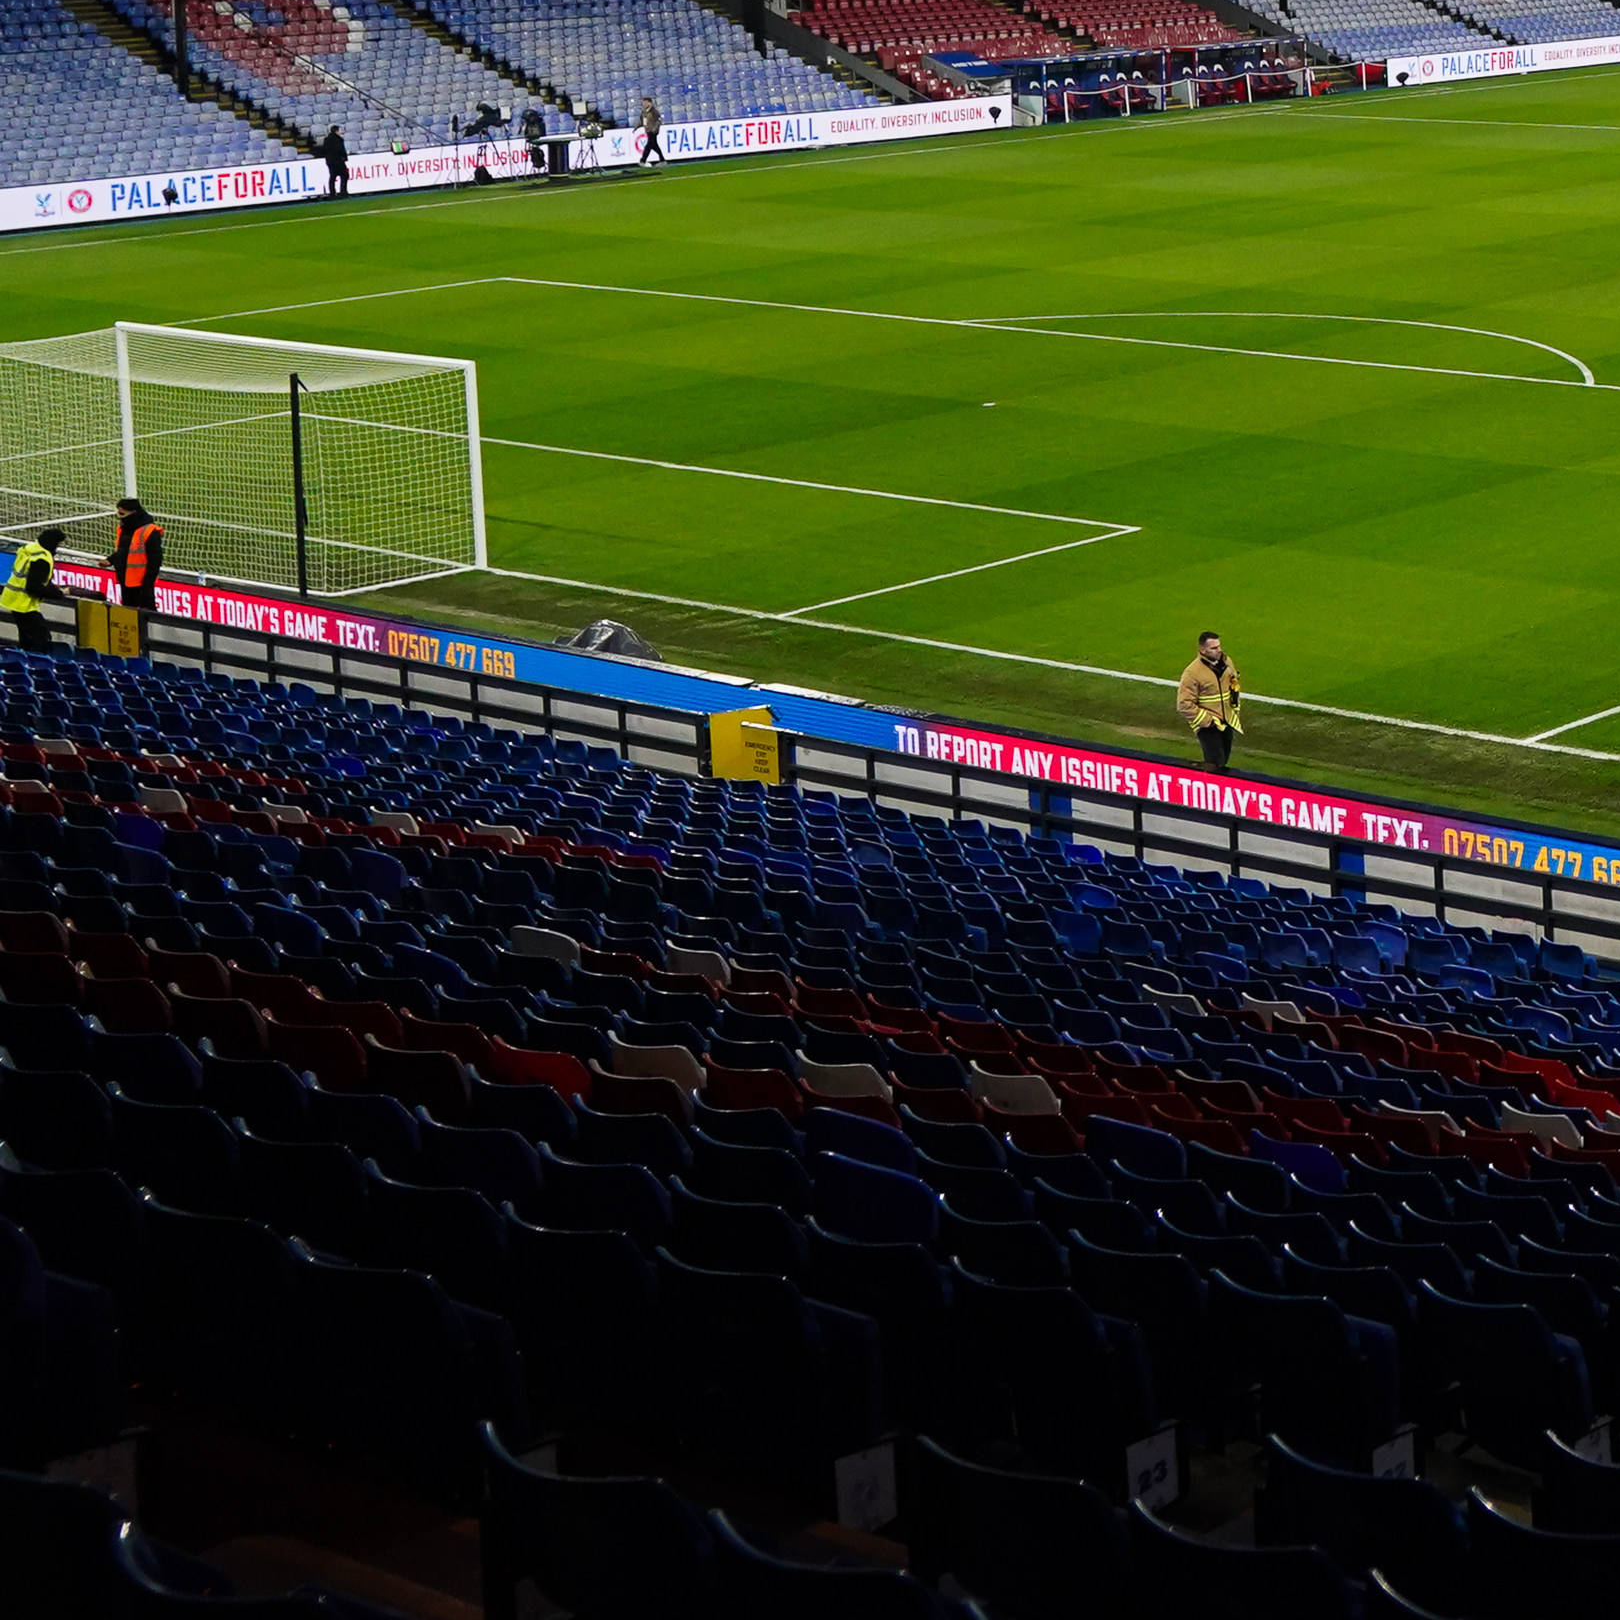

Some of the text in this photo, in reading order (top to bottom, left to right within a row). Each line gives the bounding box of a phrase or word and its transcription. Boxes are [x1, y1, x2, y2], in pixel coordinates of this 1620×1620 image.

[196, 594, 213, 622] AT
[217, 597, 279, 638] TODAY'S
[387, 630, 439, 664] 07507
[445, 642, 476, 670] 477
[482, 648, 515, 679] 669
[893, 725, 920, 753] TO
[1011, 747, 1053, 780] ANY
[1146, 773, 1171, 803] AT
[1178, 778, 1273, 824] TODAY'S
[1443, 828, 1525, 869] 07507
[1533, 846, 1583, 878] 477
